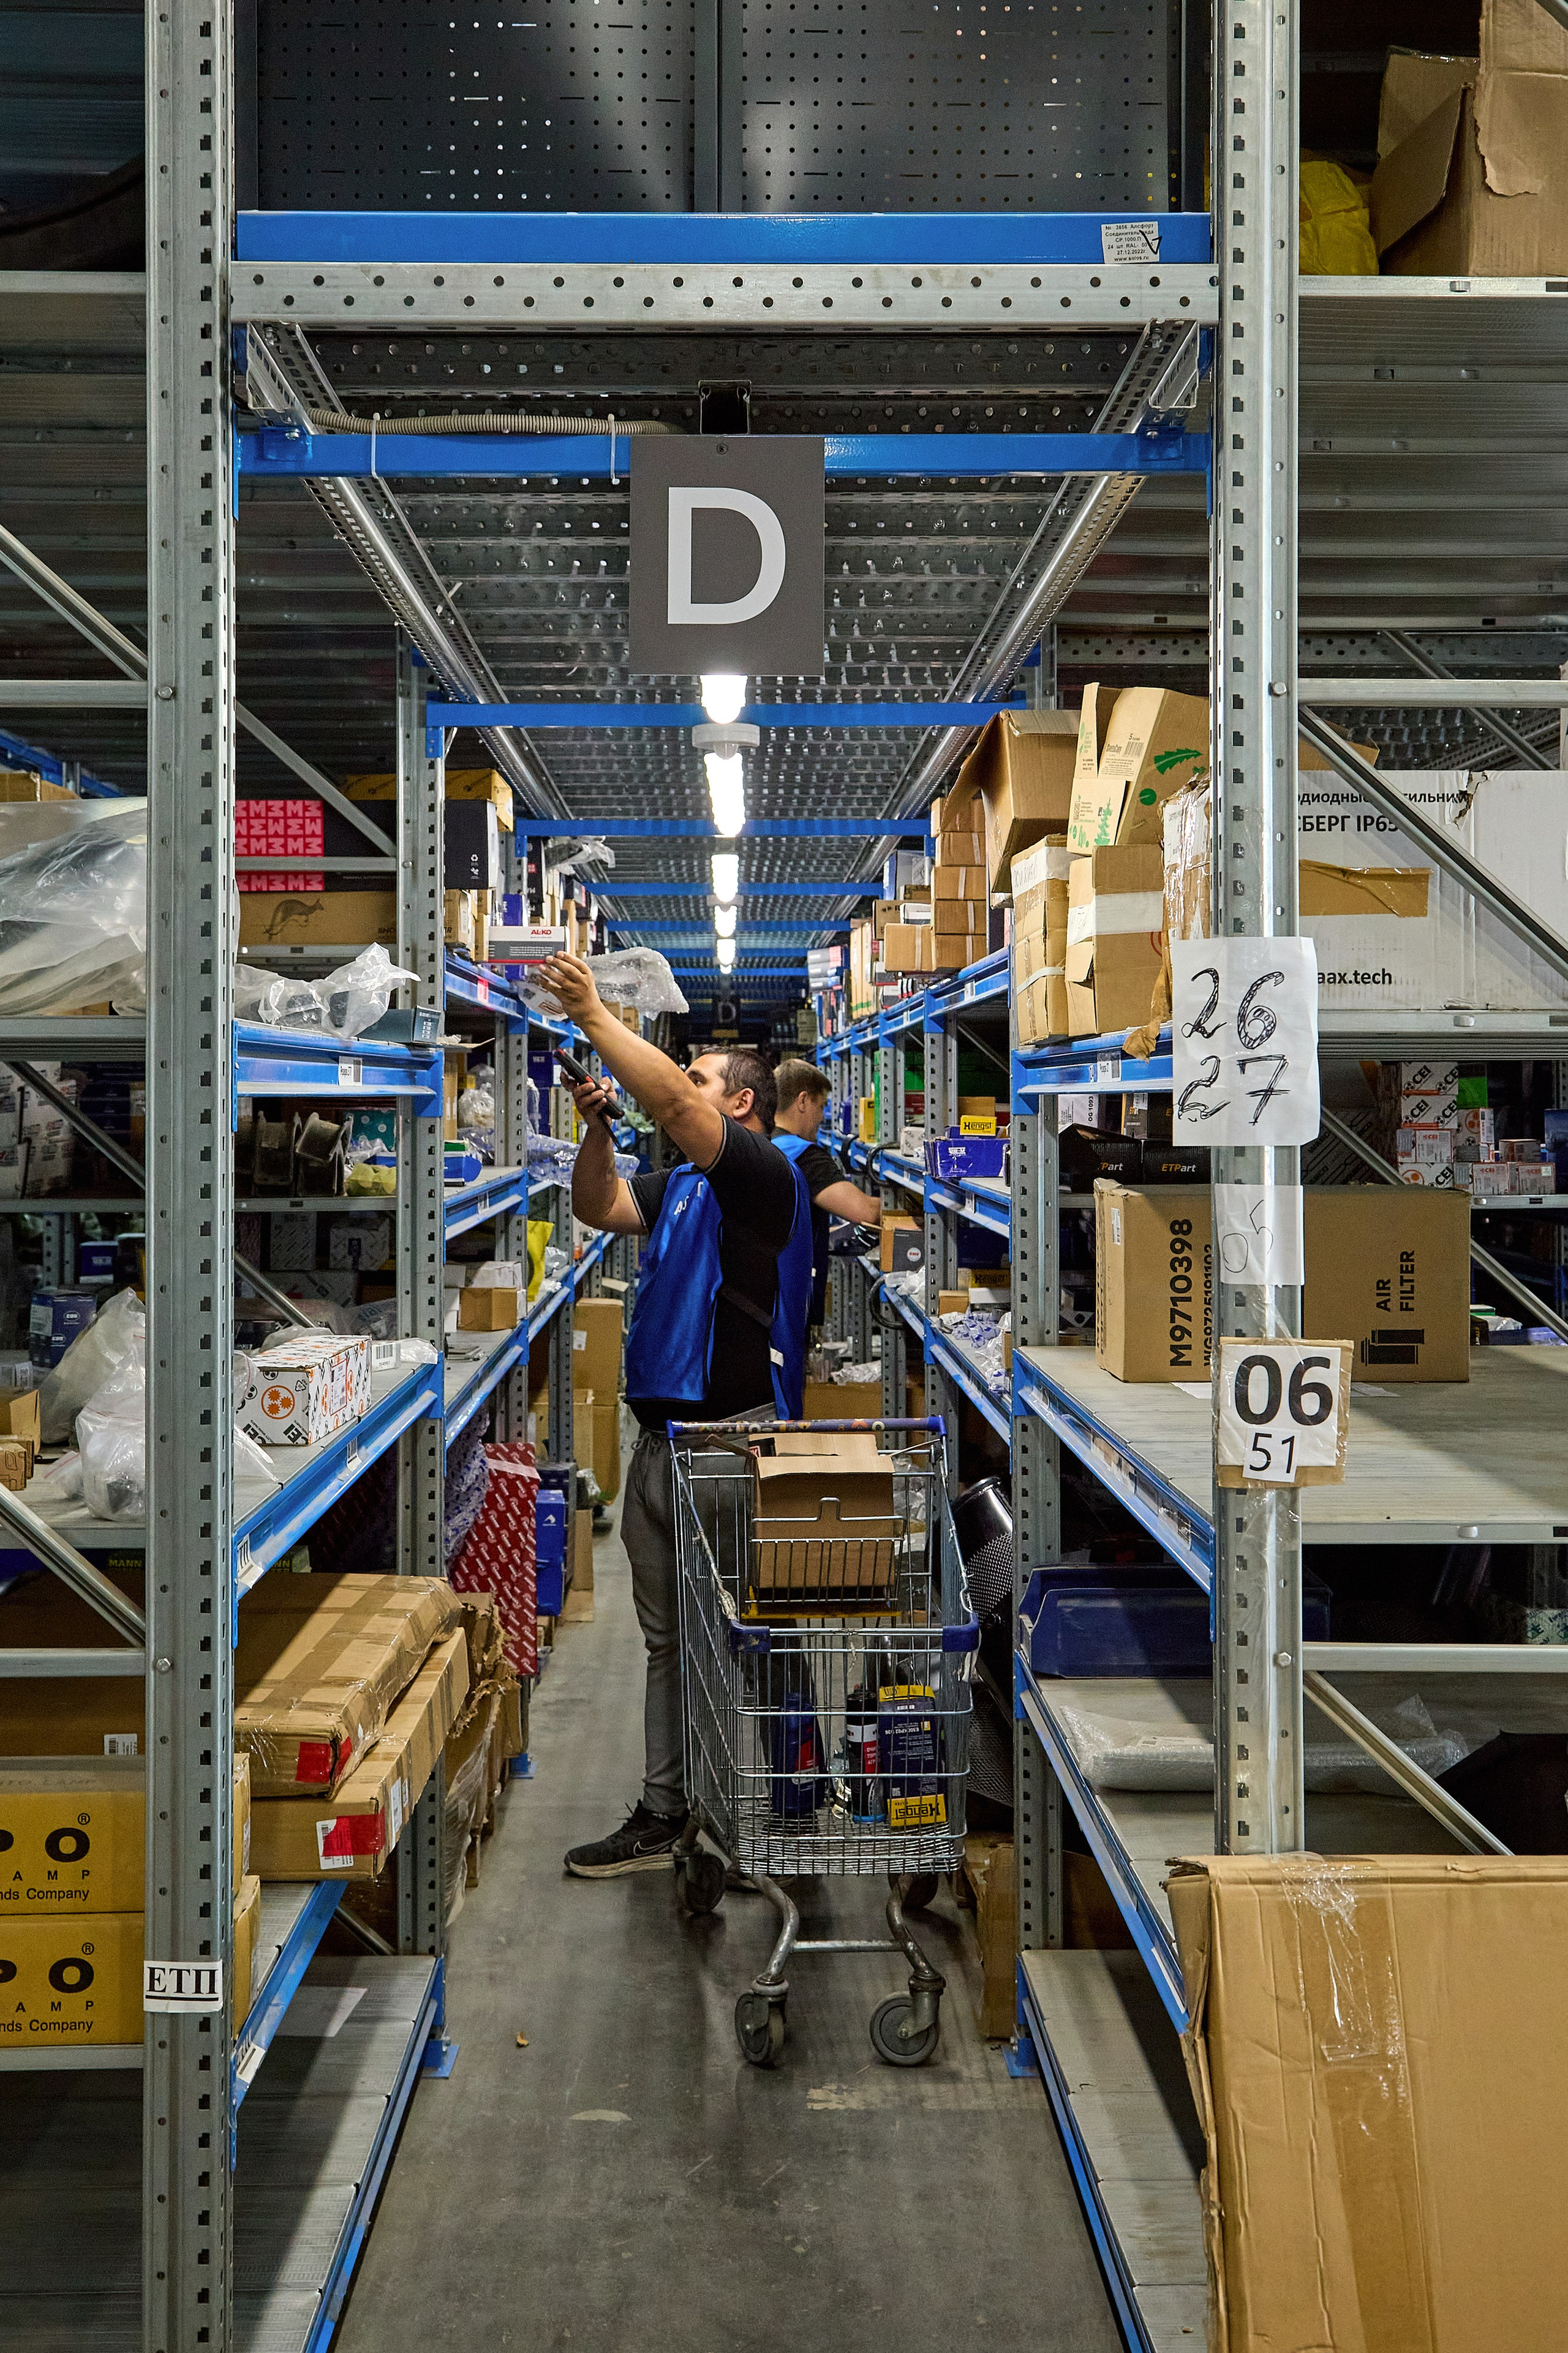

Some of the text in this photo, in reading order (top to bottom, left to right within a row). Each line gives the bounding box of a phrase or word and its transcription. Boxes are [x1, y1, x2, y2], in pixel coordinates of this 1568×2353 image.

[668, 487, 786, 624] D
[1182, 967, 1285, 1050] 26
[1177, 1054, 1291, 1127] 27
[1412, 1065, 1431, 1084] CEI
[1411, 1098, 1430, 1119] CEI
[963, 1122, 992, 1130] Hengst
[1161, 1163, 1196, 1173] ETPart
[1436, 1166, 1453, 1186] CEI
[1169, 1218, 1193, 1367] M9710398
[1376, 1278, 1391, 1312] AIR
[1400, 1250, 1415, 1312] FILTER
[1235, 1355, 1334, 1426] 06
[1249, 1433, 1297, 1474] 51
[26, 1888, 89, 1901] Company
[29, 2020, 94, 2033] Company
